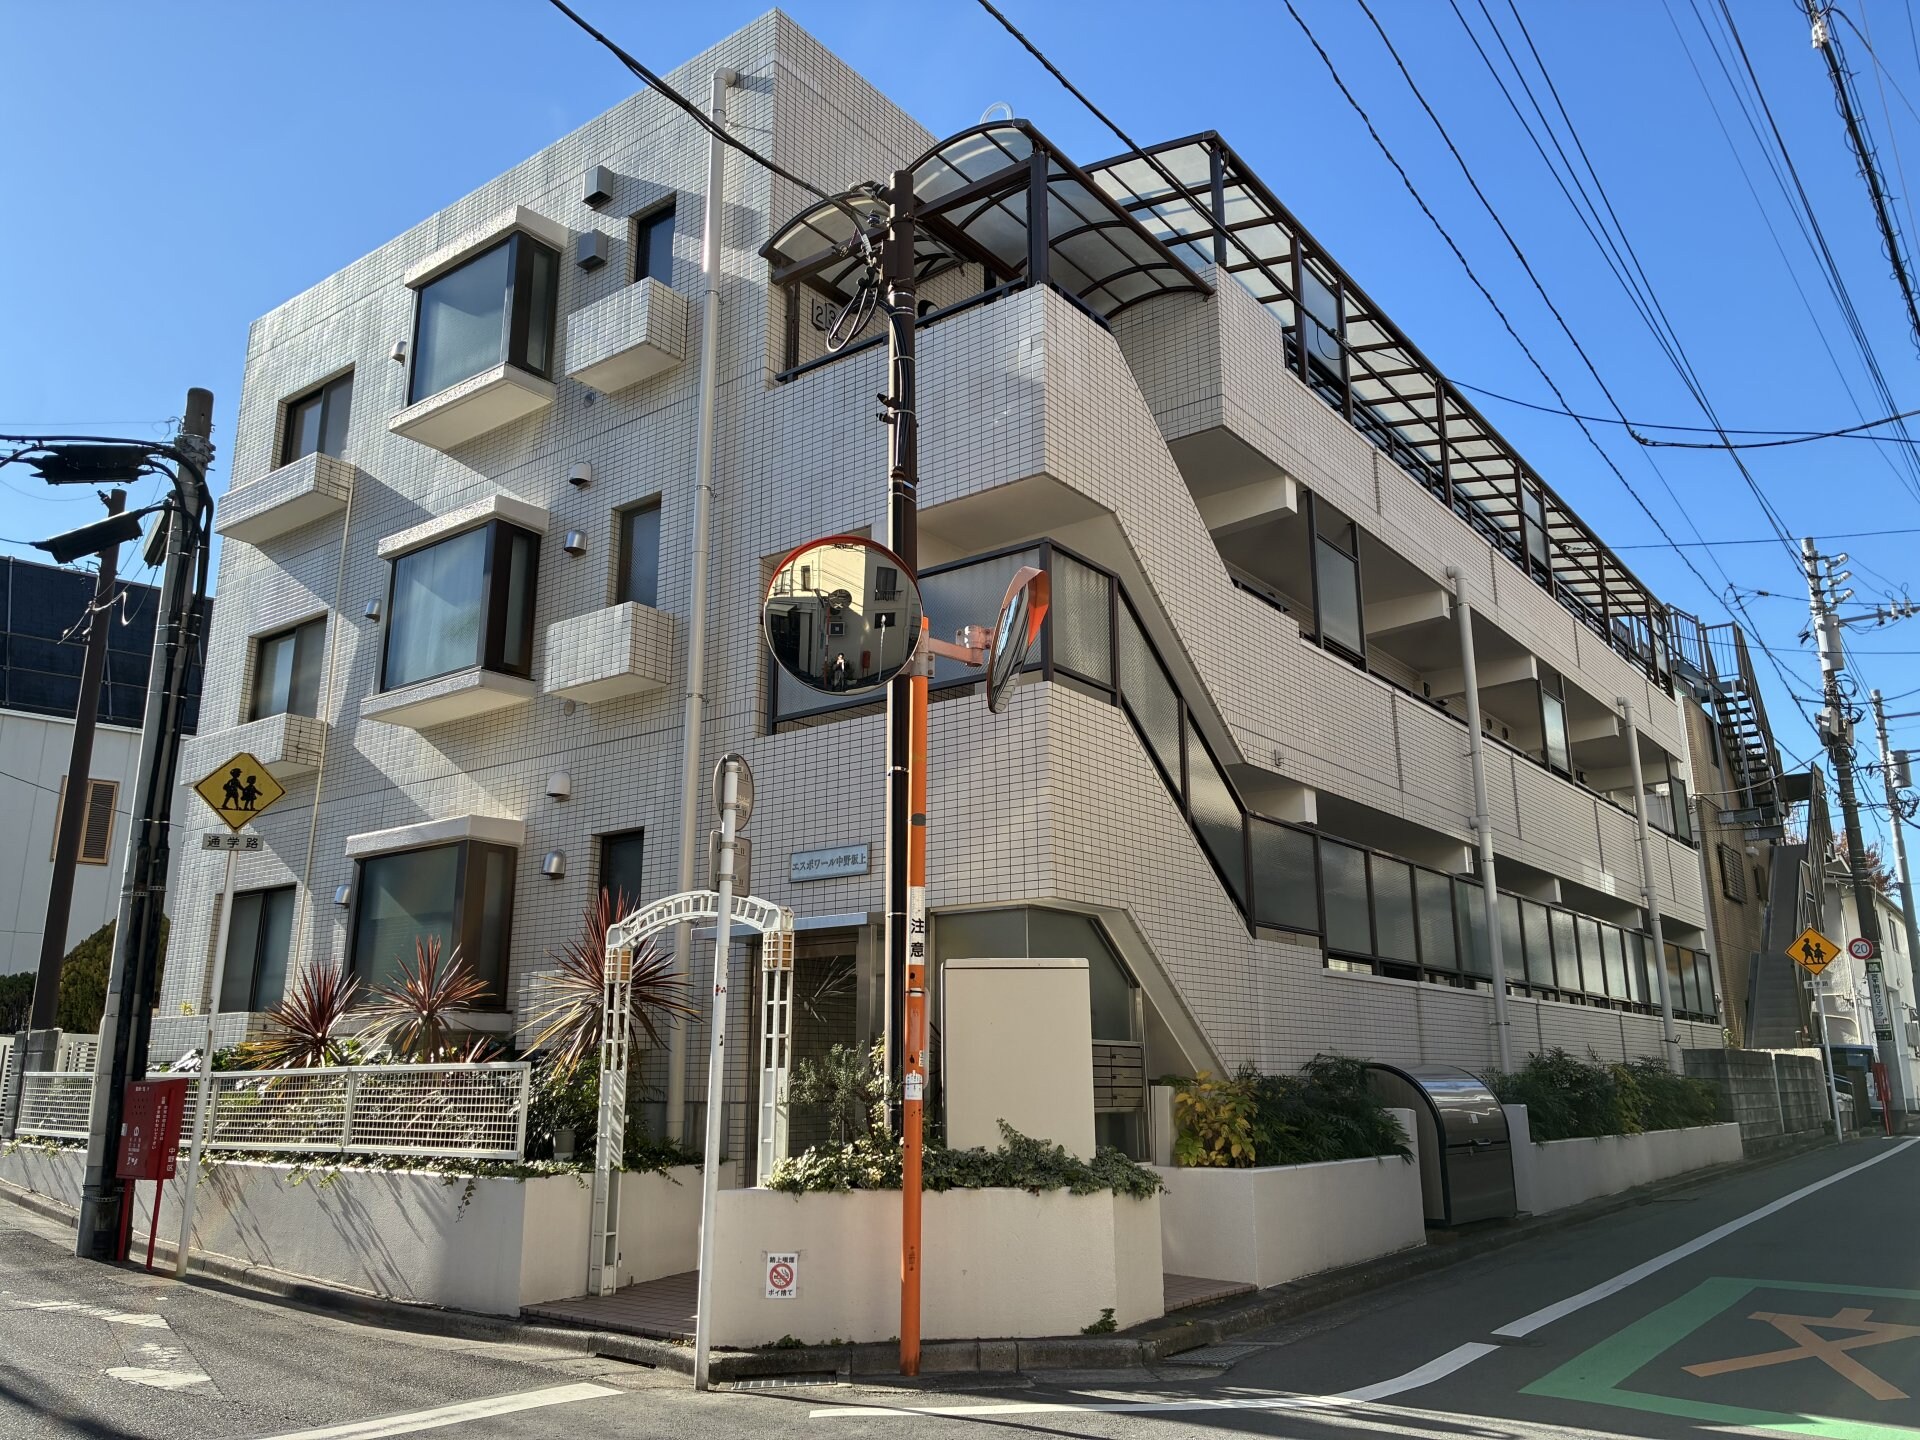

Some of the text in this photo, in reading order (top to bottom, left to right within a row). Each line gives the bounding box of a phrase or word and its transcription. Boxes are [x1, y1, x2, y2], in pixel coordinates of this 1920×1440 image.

[207, 836, 258, 849] 通学路
[792, 853, 866, 871] エスポワール中野坂上
[911, 918, 924, 958] 注意
[1854, 944, 1868, 953] 20
[167, 1147, 176, 1172] 中野区
[769, 1256, 795, 1264] 路上喫煙
